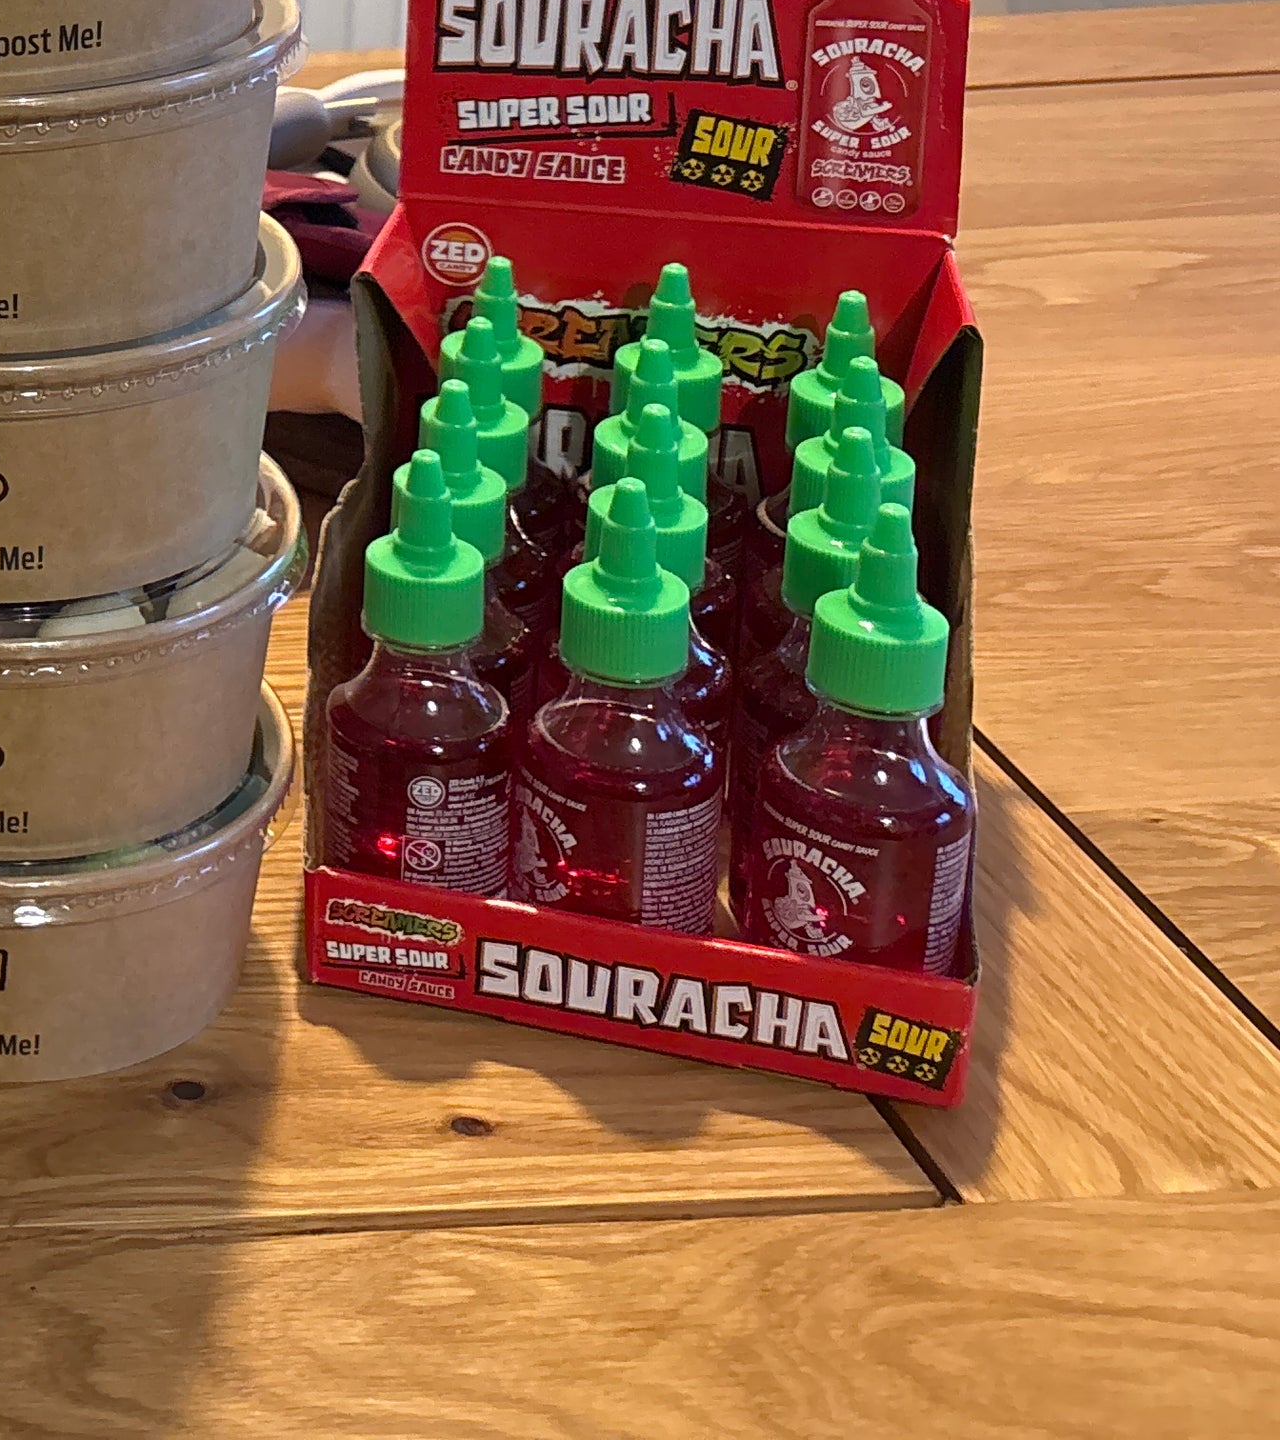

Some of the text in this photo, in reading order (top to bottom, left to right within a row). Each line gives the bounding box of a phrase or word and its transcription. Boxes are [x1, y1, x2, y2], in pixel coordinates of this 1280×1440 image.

[59, 20, 103, 53] Me!
[811, 37, 926, 73] SOURACHA
[457, 92, 651, 130] SUPER SOUR
[691, 116, 778, 167] SOUR
[811, 120, 912, 149] SUPER SOUR
[440, 145, 626, 185] CANDY SAUCE
[811, 159, 911, 184] SCREAMERS
[430, 240, 485, 264] ZED
[0, 545, 44, 571] Me!
[762, 838, 867, 900] SOURACHA
[328, 900, 458, 942] SCREAMERS
[326, 941, 450, 970] SUPER SOUR
[807, 935, 853, 957] SOUR
[359, 970, 456, 999] CANDY SAUCE
[477, 939, 851, 1061] SOURACHA
[868, 1013, 949, 1063] SOUR
